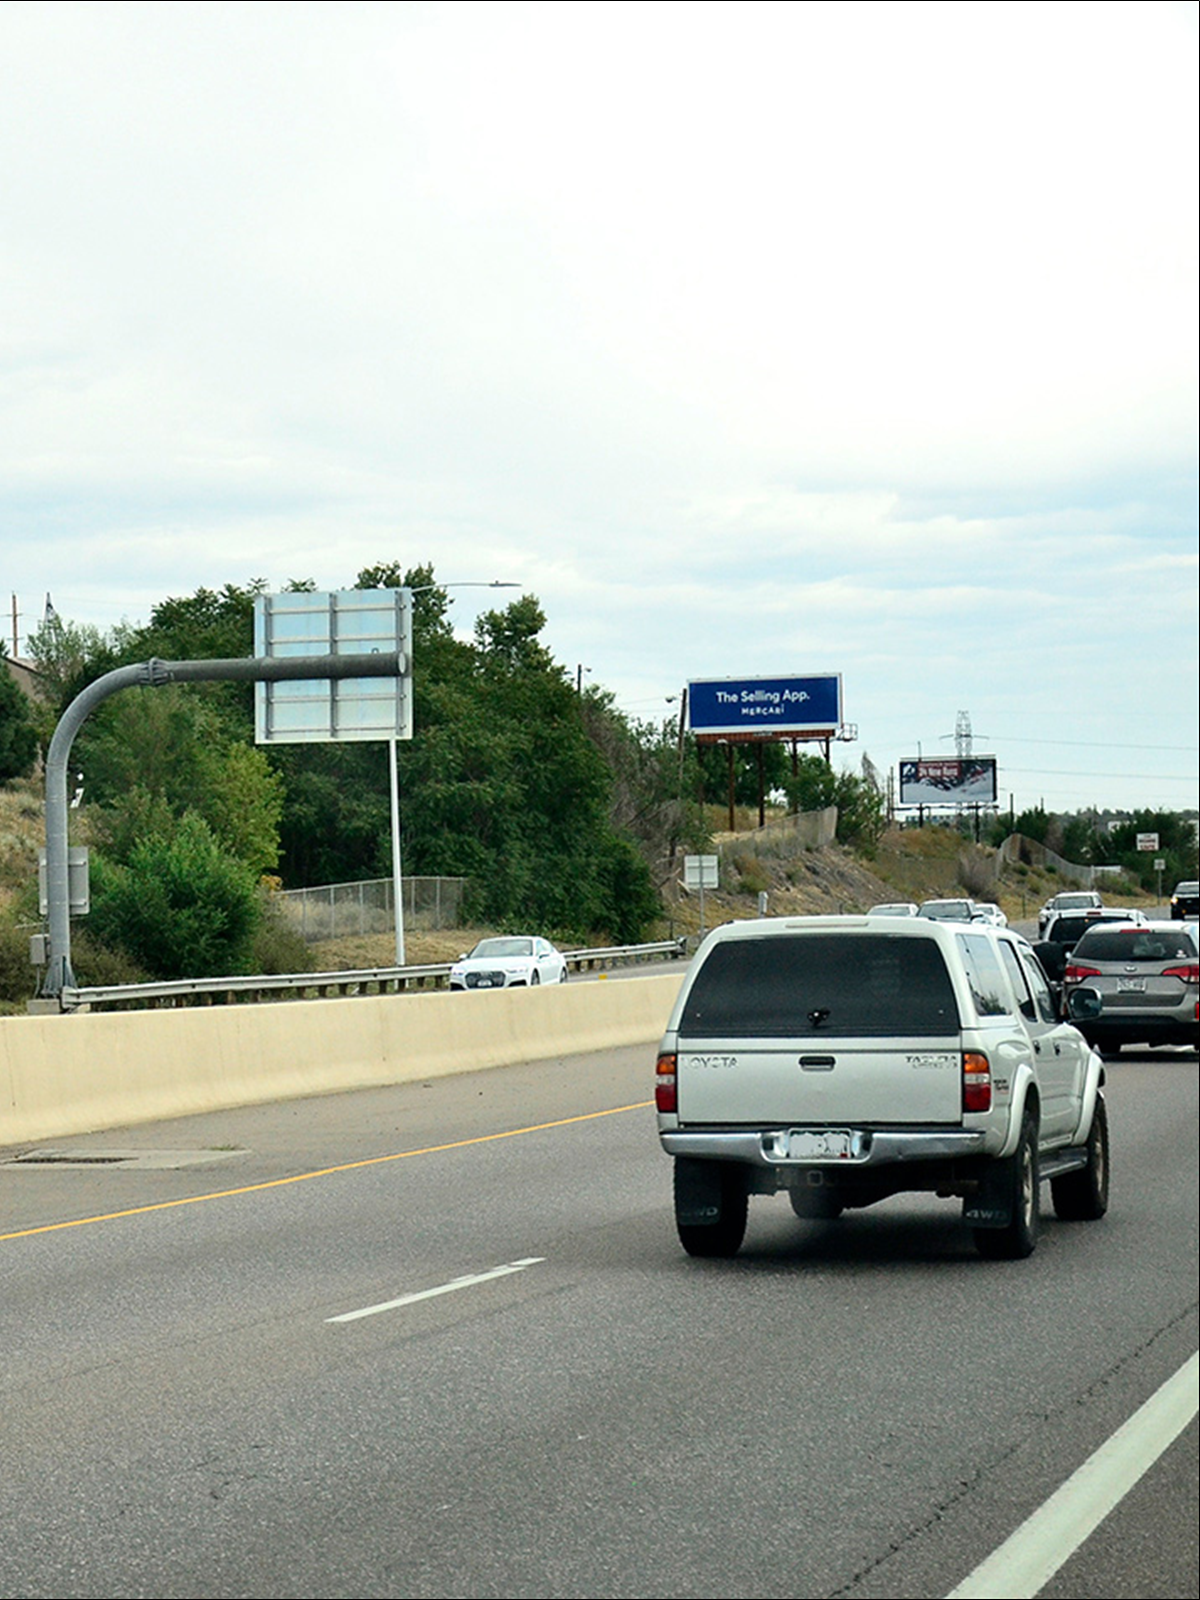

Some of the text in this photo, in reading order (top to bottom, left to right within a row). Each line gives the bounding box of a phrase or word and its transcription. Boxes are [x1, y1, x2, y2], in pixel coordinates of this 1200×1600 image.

[716, 689, 810, 704] The Selling App.
[680, 1056, 740, 1069] OYOTA
